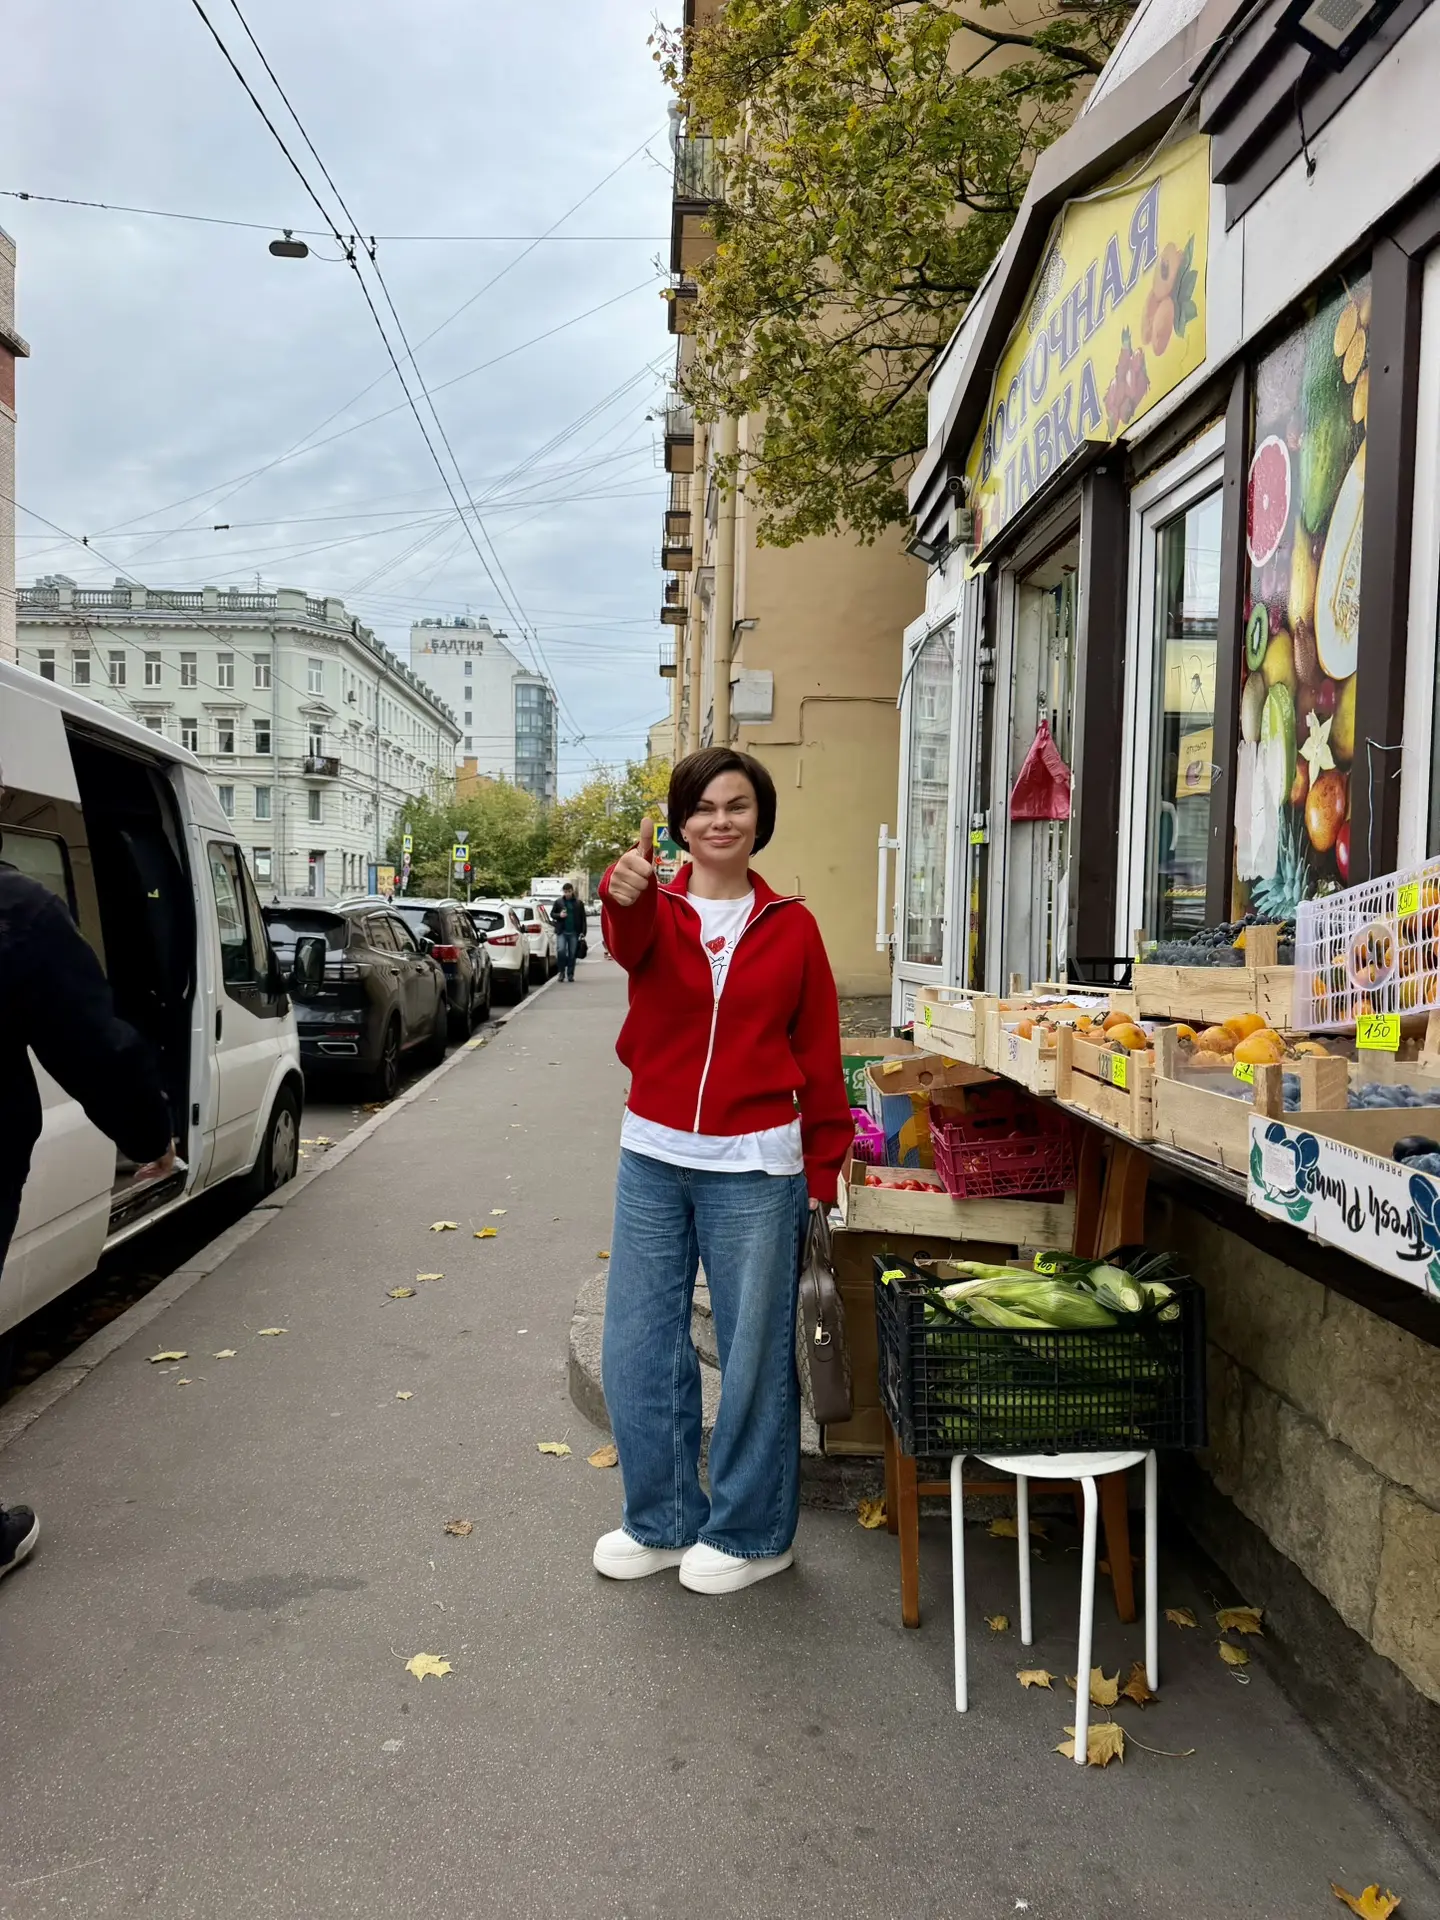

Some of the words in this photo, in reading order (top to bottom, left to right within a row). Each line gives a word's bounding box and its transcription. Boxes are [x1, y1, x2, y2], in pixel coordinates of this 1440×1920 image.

[981, 175, 1161, 488] ВОСТОЧНАЯ
[1001, 359, 1102, 525] ЛАВКА
[431, 639, 484, 651] БАЛТИЯ
[1364, 1022, 1391, 1039] 150
[1324, 1140, 1359, 1160] QUALITY
[1362, 1154, 1402, 1177] PREMIUM
[1305, 1167, 1366, 1233] Plums
[1368, 1185, 1434, 1262] Fresh
